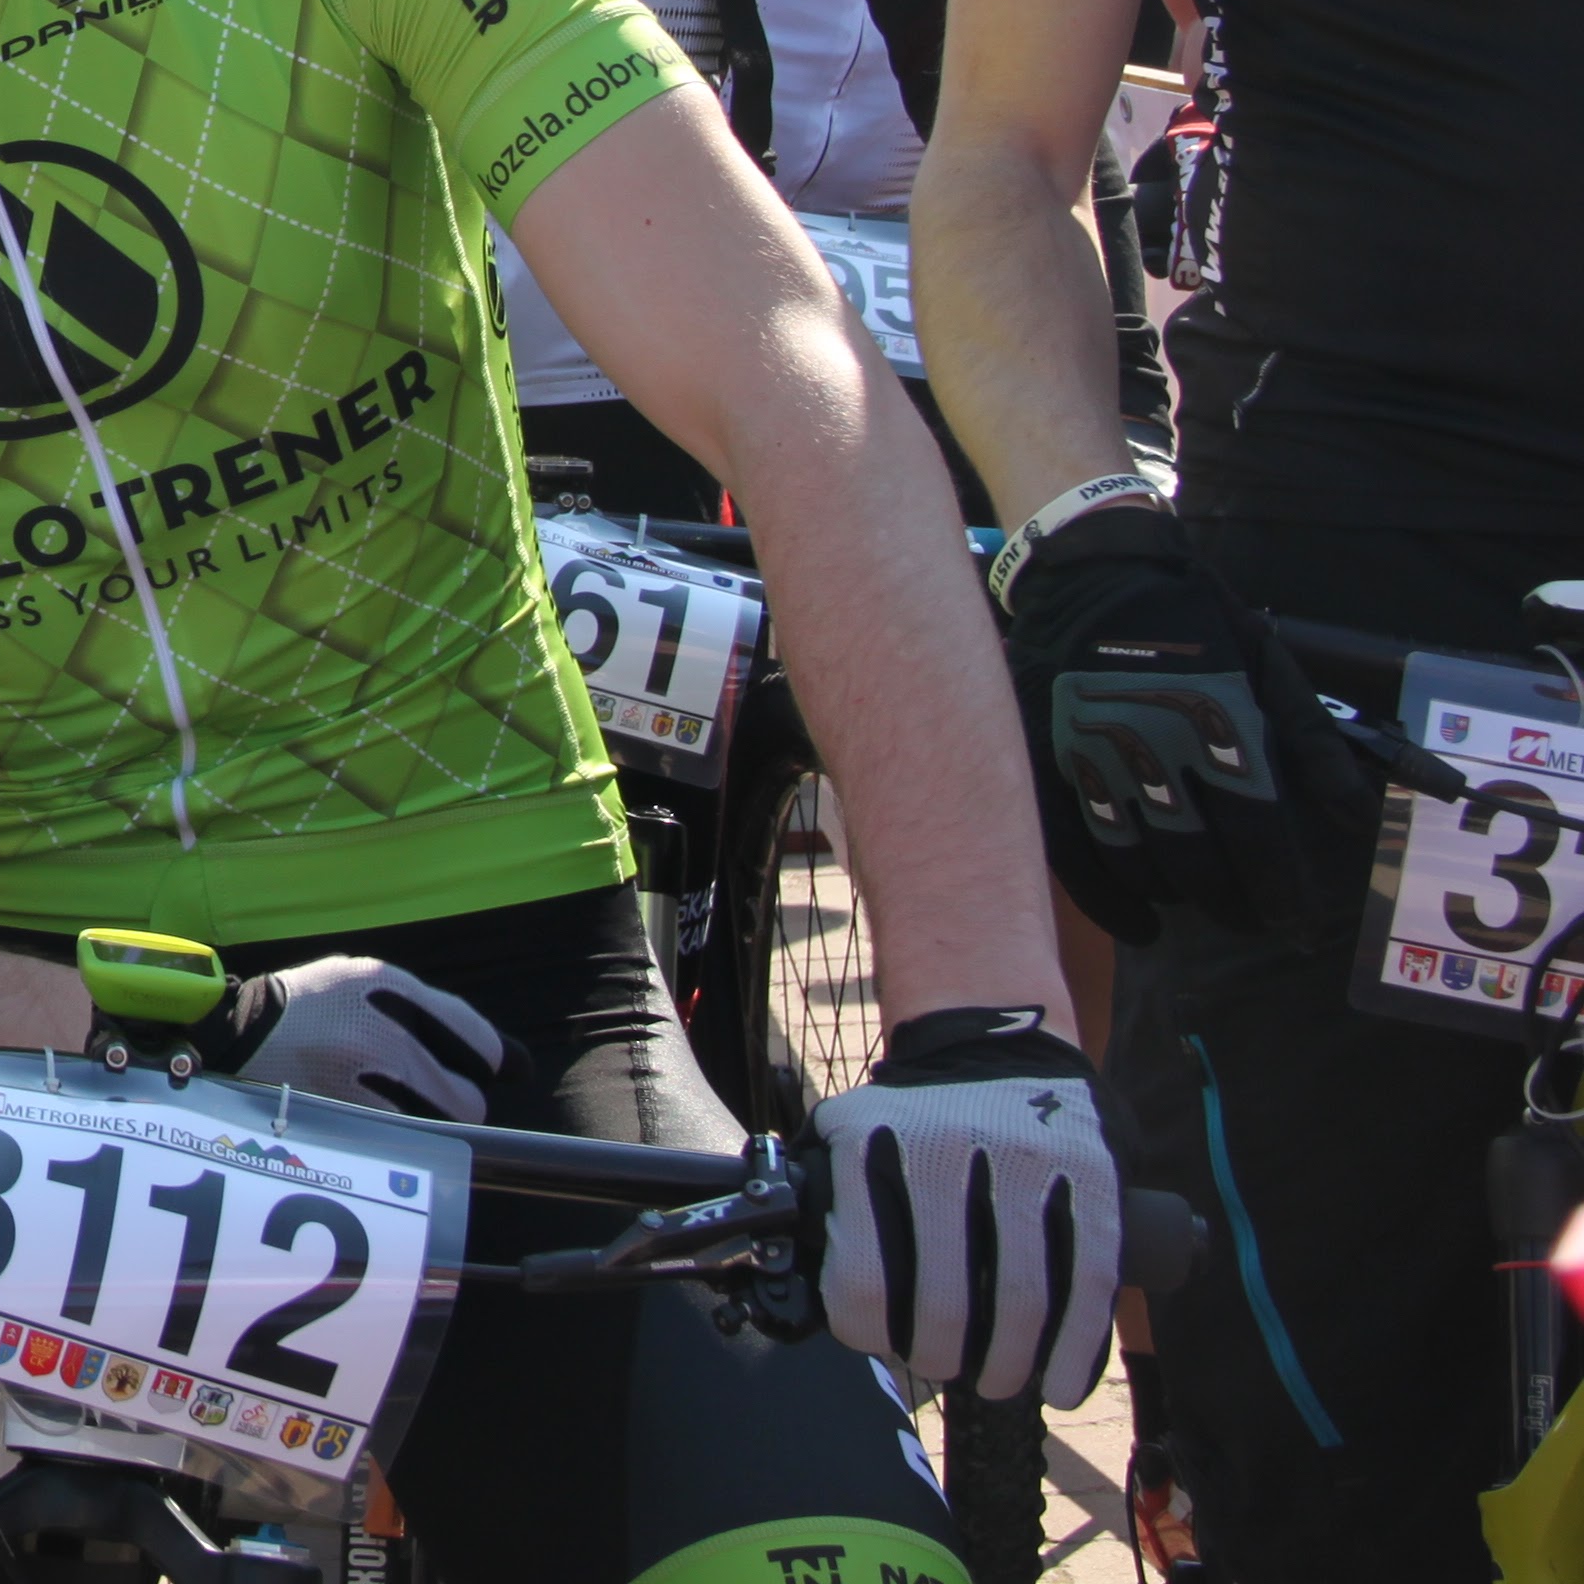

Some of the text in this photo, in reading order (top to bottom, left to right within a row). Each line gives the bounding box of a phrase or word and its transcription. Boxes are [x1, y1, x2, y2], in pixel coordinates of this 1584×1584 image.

[60, 546, 222, 606] YOUR
[236, 459, 406, 564] LIMITS
[4, 1100, 169, 1144] METROBIKES.PL
[682, 1202, 732, 1227] XT
[650, 1258, 695, 1271] SHIMANO
